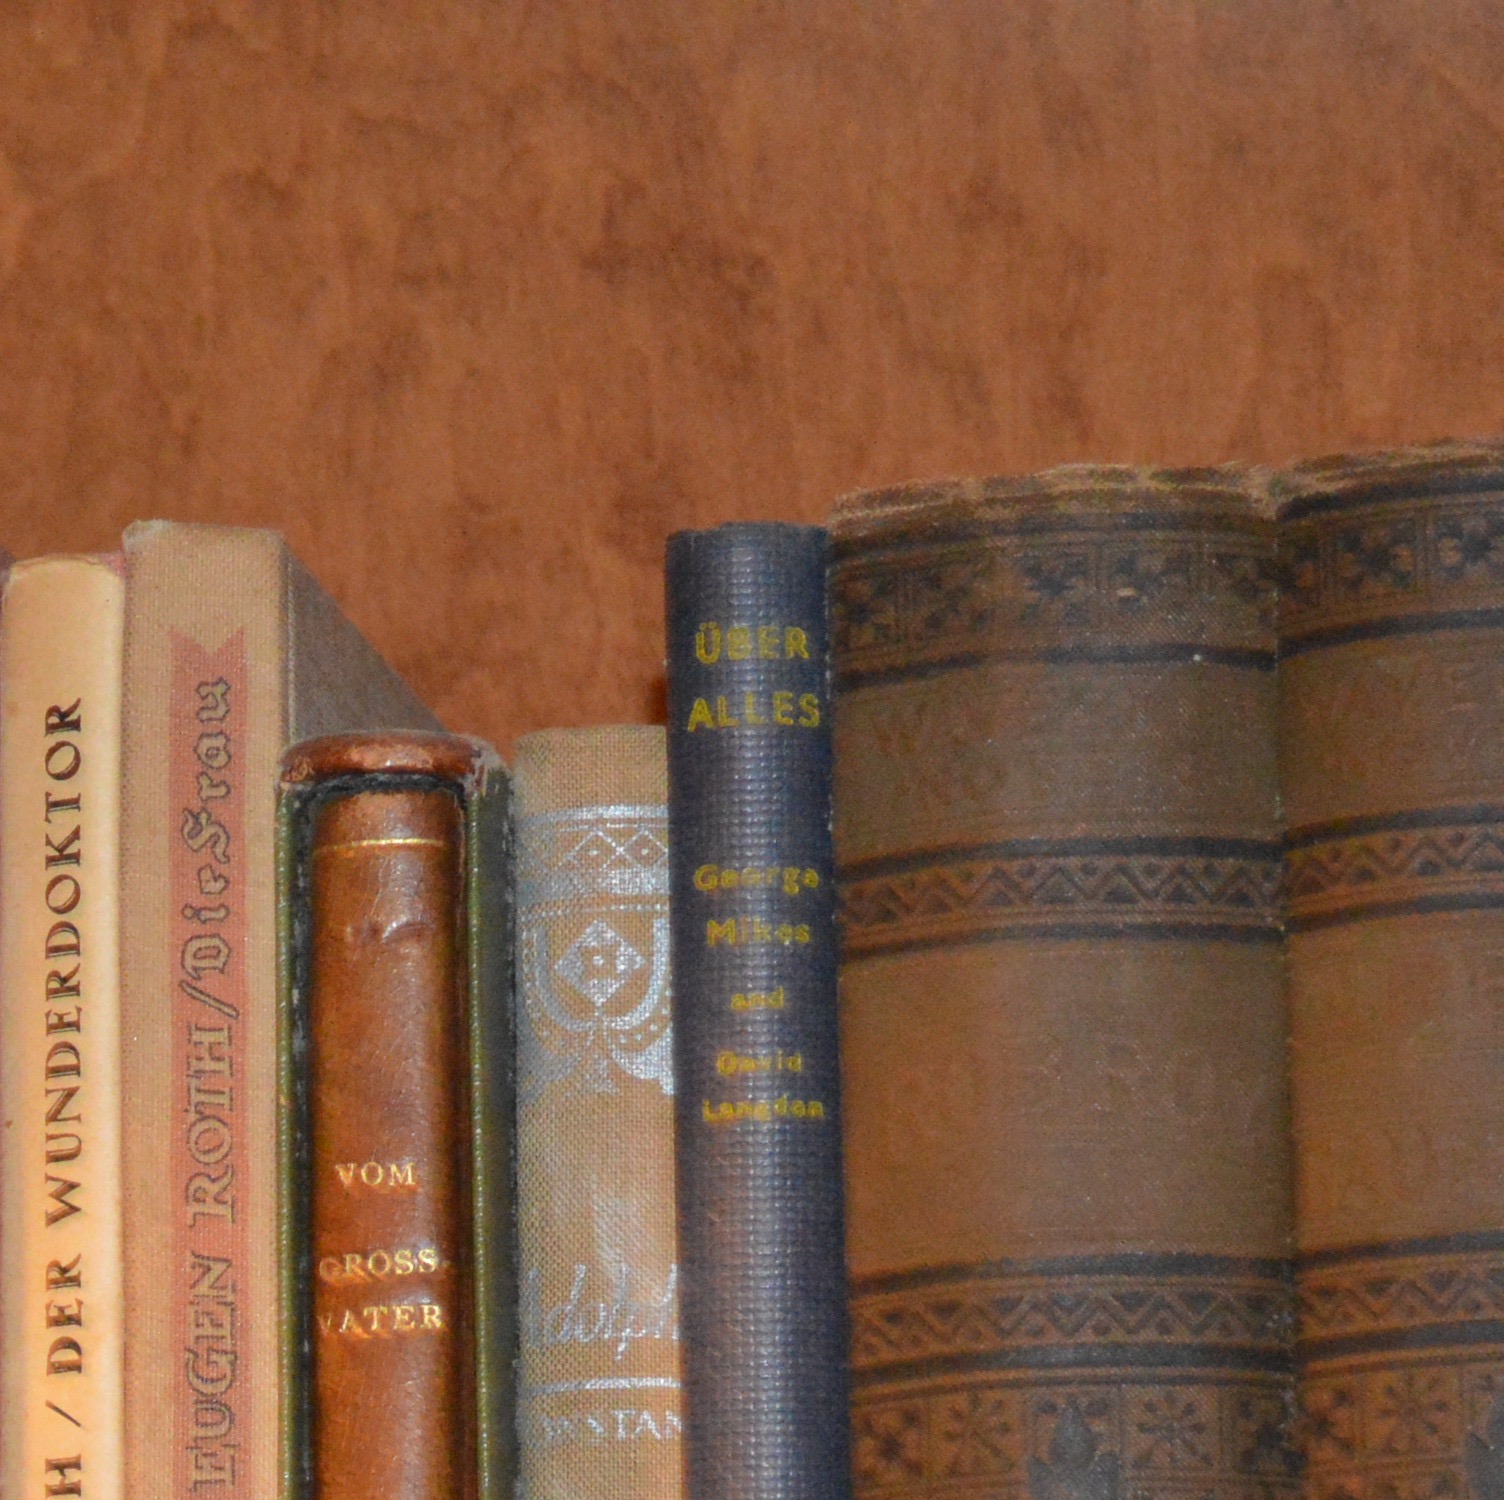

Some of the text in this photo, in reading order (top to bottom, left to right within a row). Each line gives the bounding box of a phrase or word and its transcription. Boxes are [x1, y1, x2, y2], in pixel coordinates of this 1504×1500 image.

[696, 621, 809, 665] ÜBER
[687, 690, 821, 733] ALLES
[694, 863, 820, 895] George
[706, 918, 811, 947] Mikes
[45, 698, 82, 1226] WUNDERDOKTOR
[730, 985, 785, 1010] and
[716, 1050, 803, 1076] David
[702, 1094, 825, 1123] Langdon
[336, 1162, 416, 1185] VOM
[45, 1253, 83, 1376] DER
[317, 1305, 444, 1333] VATER
[186, 1252, 236, 1493] EUGEN
